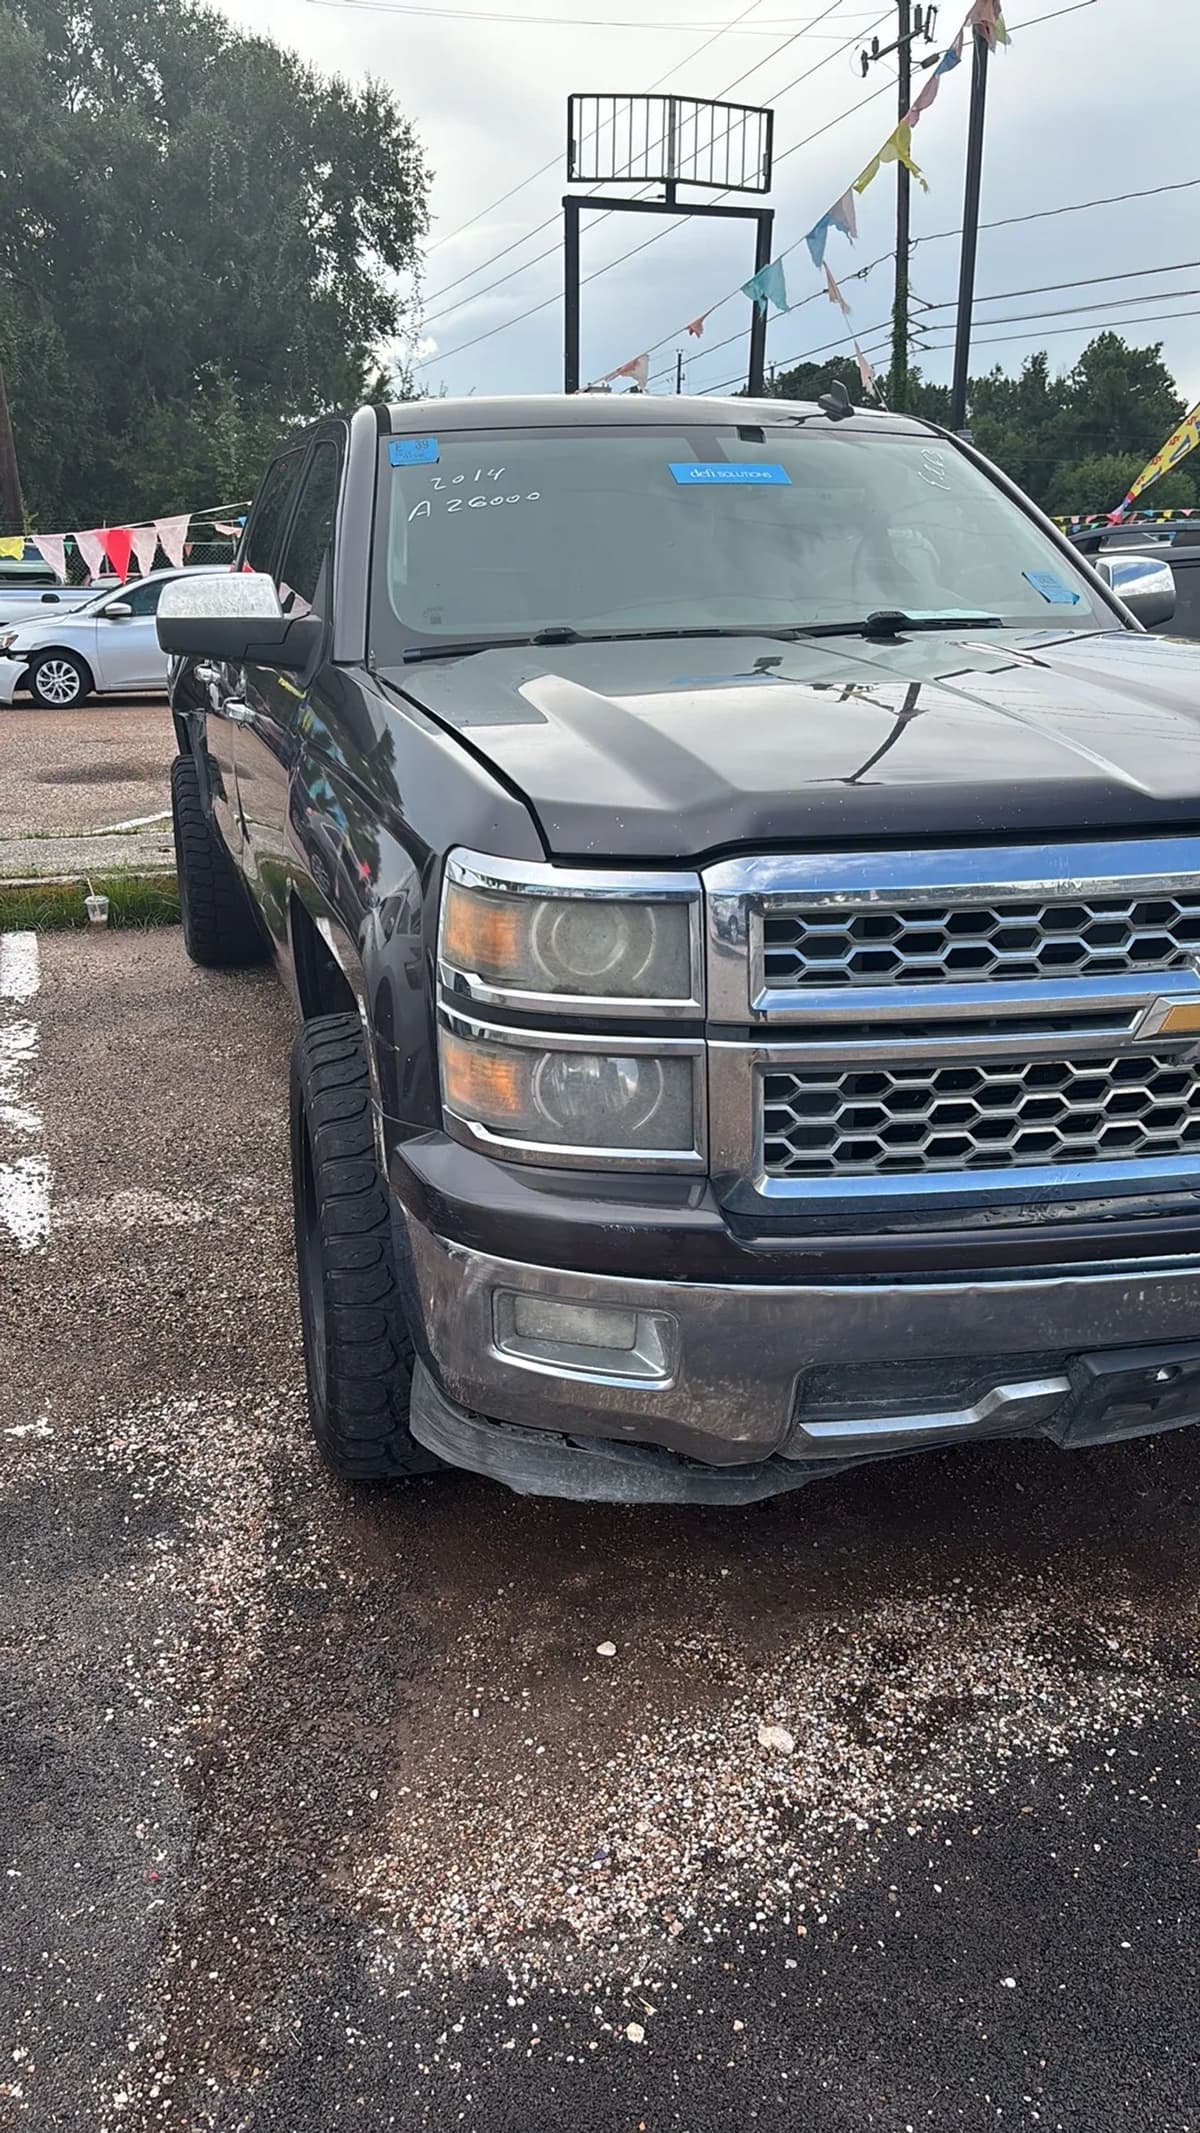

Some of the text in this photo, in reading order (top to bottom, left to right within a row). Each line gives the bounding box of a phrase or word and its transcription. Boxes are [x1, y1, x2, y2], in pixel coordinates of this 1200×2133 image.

[431, 468, 506, 490] 2014
[408, 491, 541, 522] A 26000
